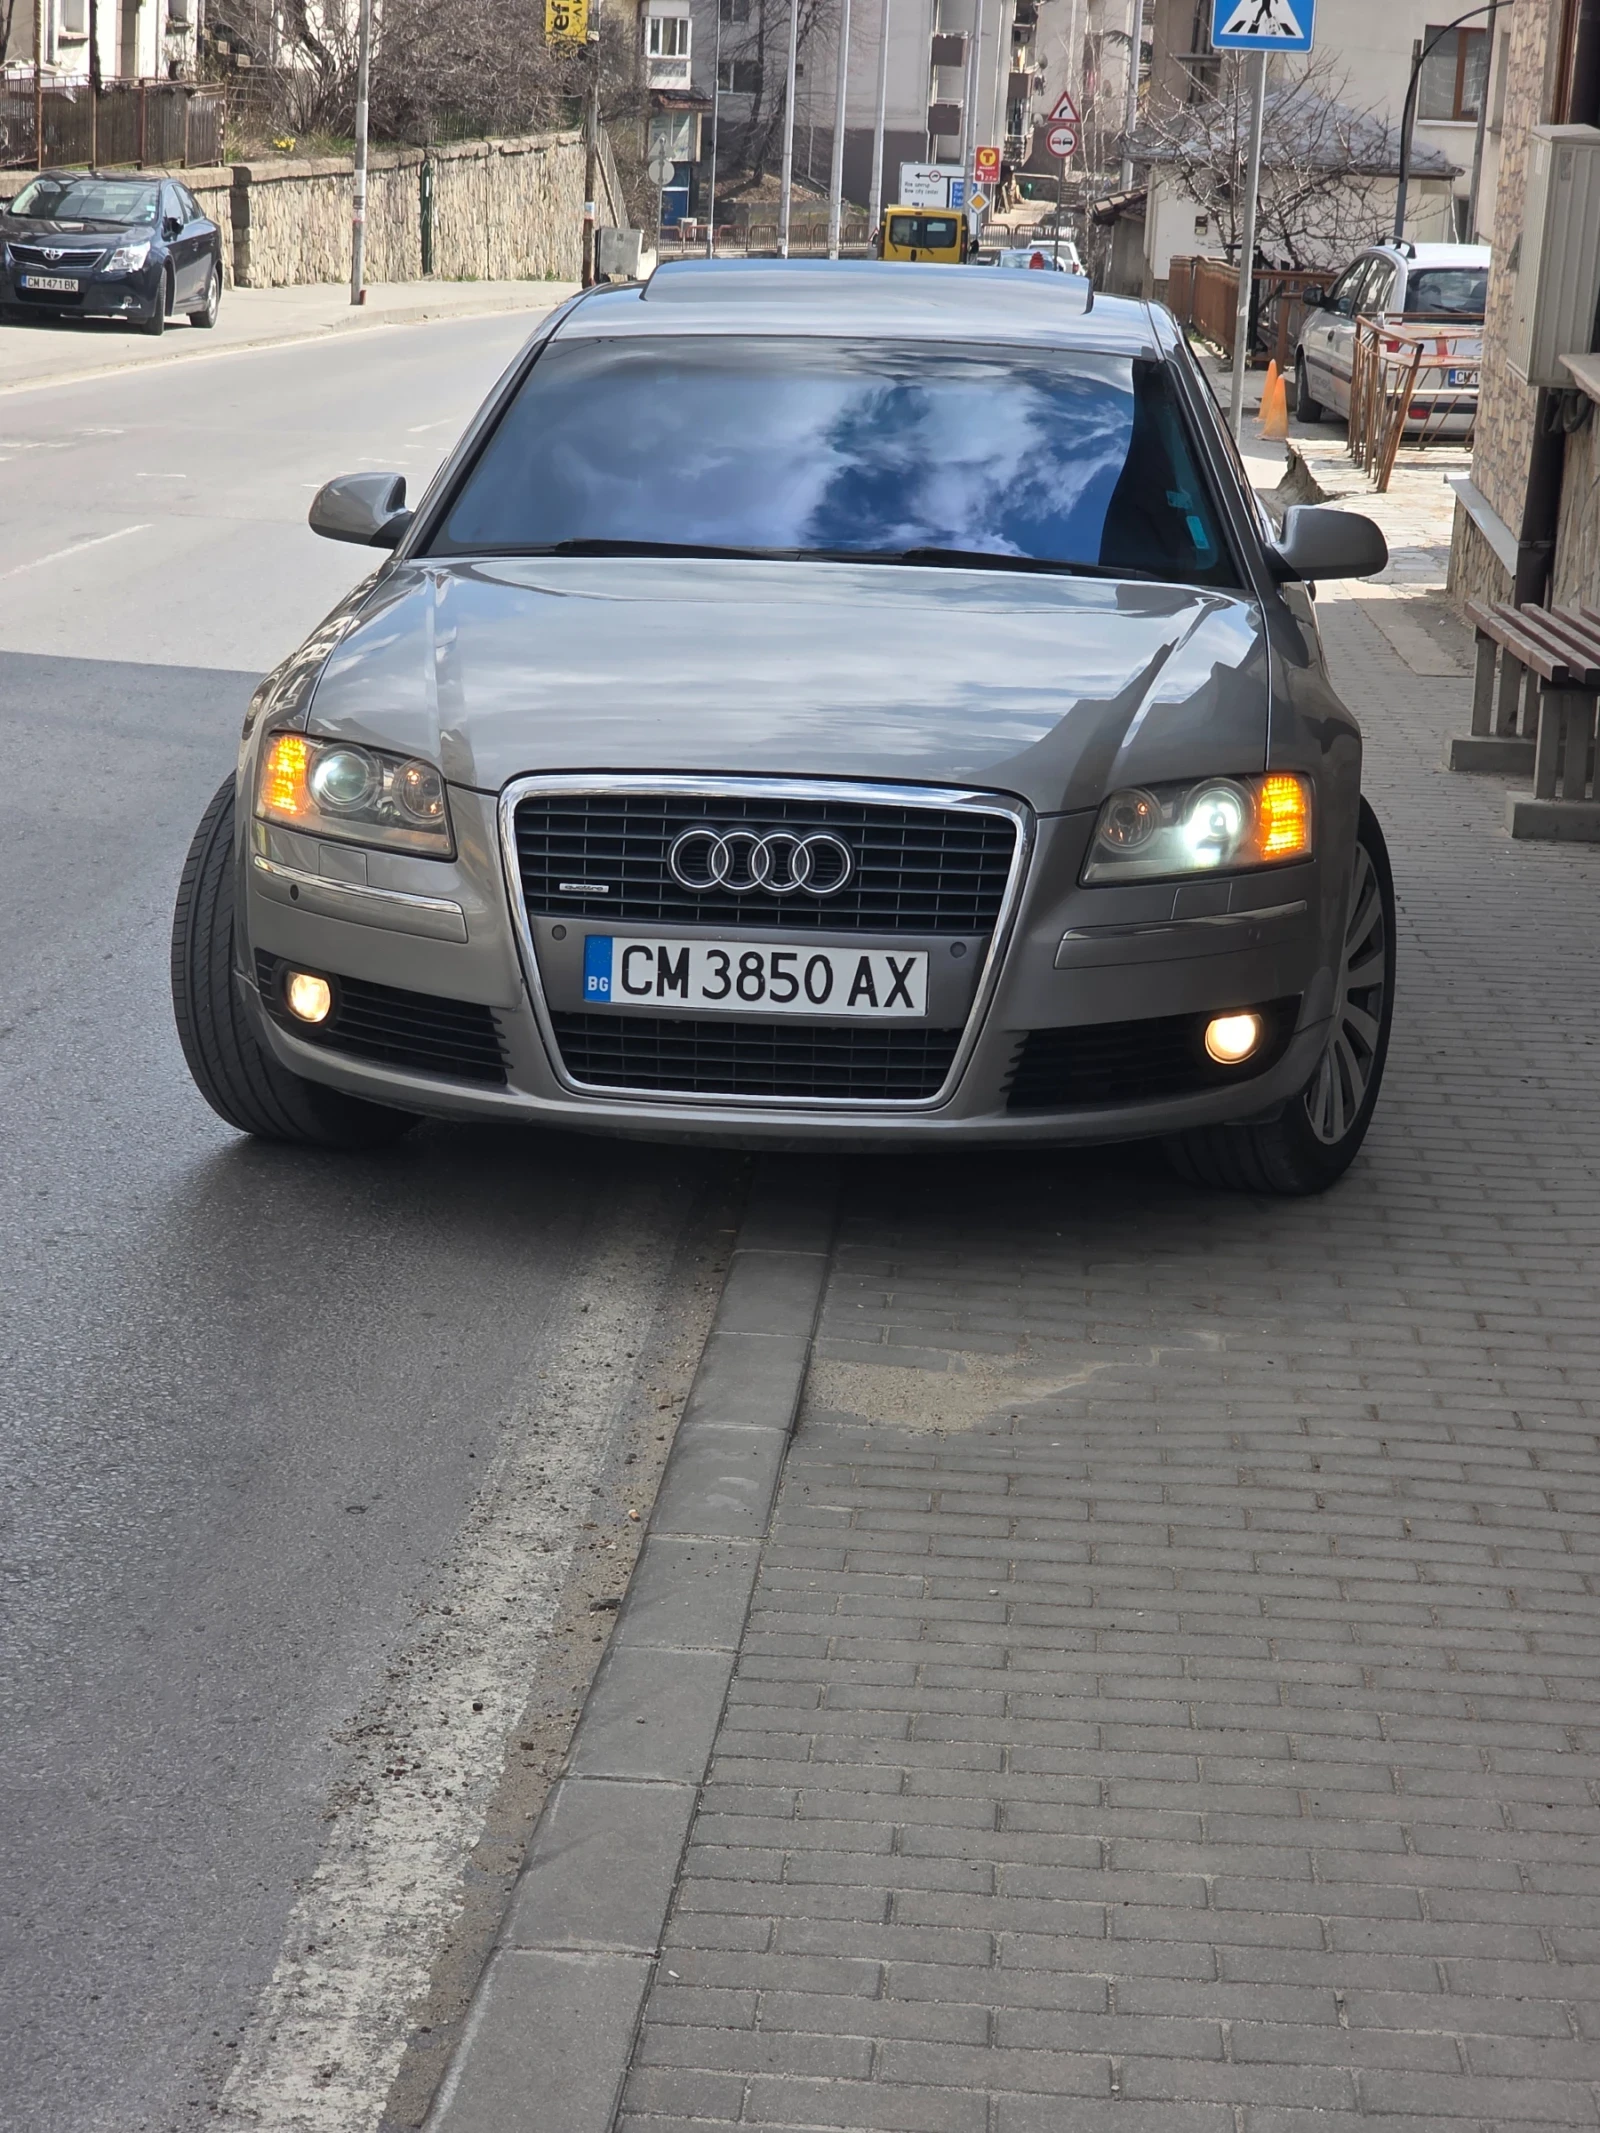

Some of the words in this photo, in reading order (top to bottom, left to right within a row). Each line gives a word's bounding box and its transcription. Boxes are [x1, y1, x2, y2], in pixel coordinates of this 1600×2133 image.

[551, 0, 570, 31] ef
[42, 279, 63, 289] 1471
[64, 280, 77, 290] BK
[588, 976, 609, 992] BG
[621, 945, 690, 998] CM
[702, 949, 833, 1005] 3850
[846, 956, 917, 1008] AX
